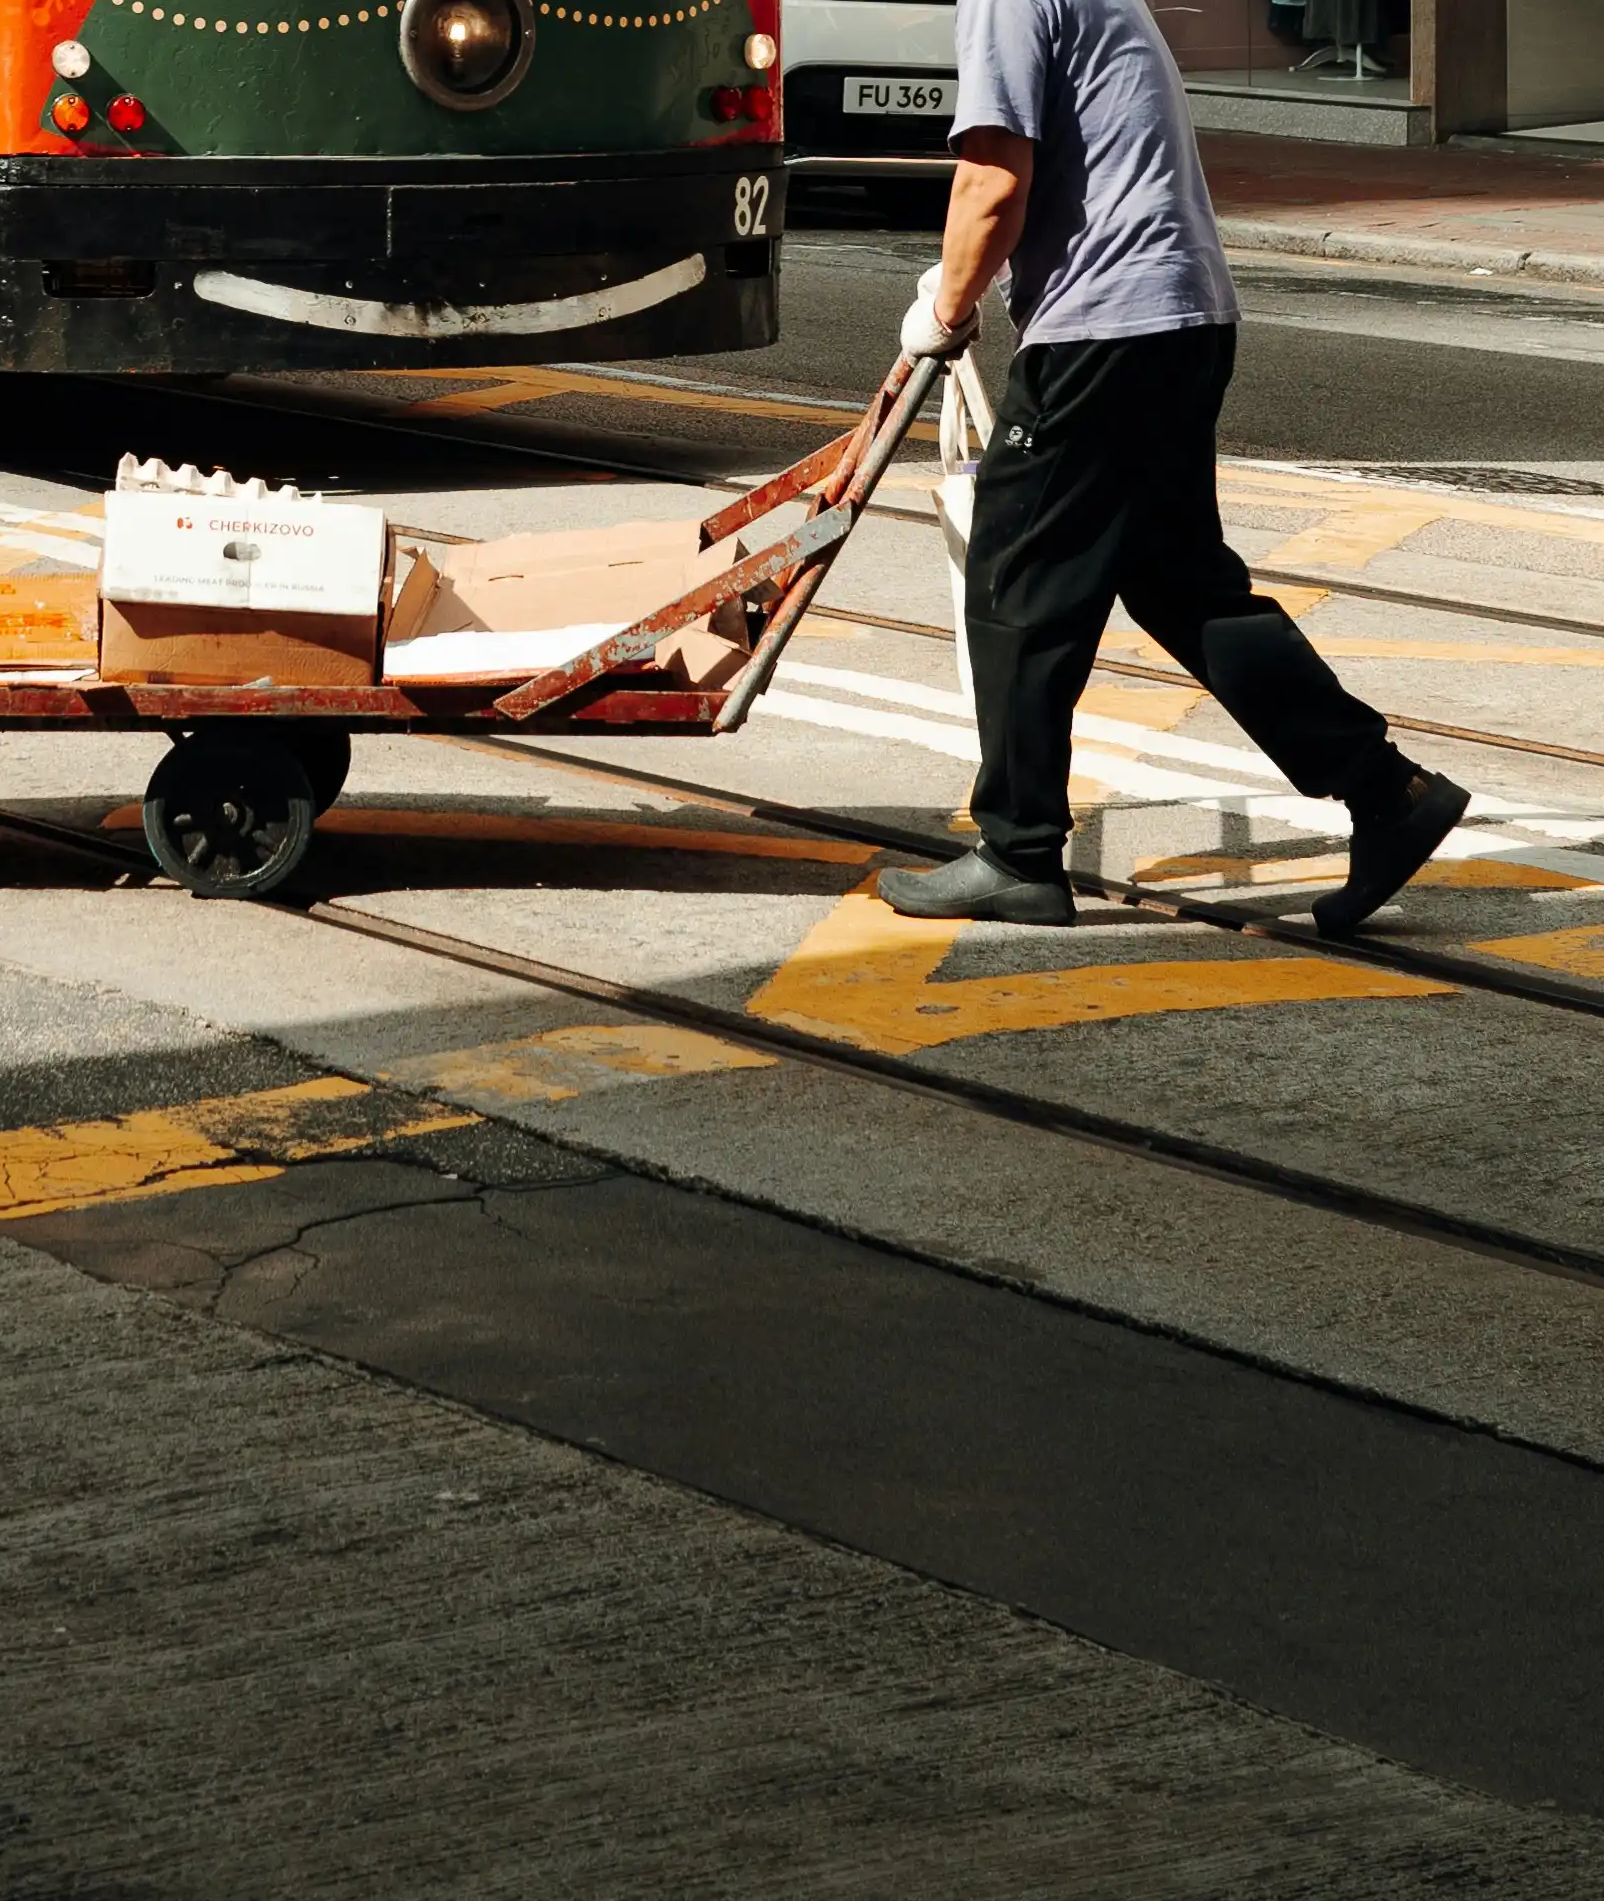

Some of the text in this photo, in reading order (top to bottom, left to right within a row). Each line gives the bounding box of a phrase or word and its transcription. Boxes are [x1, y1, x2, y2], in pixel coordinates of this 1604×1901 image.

[858, 84, 943, 109] FU 369
[734, 174, 769, 236] 82
[209, 519, 315, 537] CHERKIZOVO
